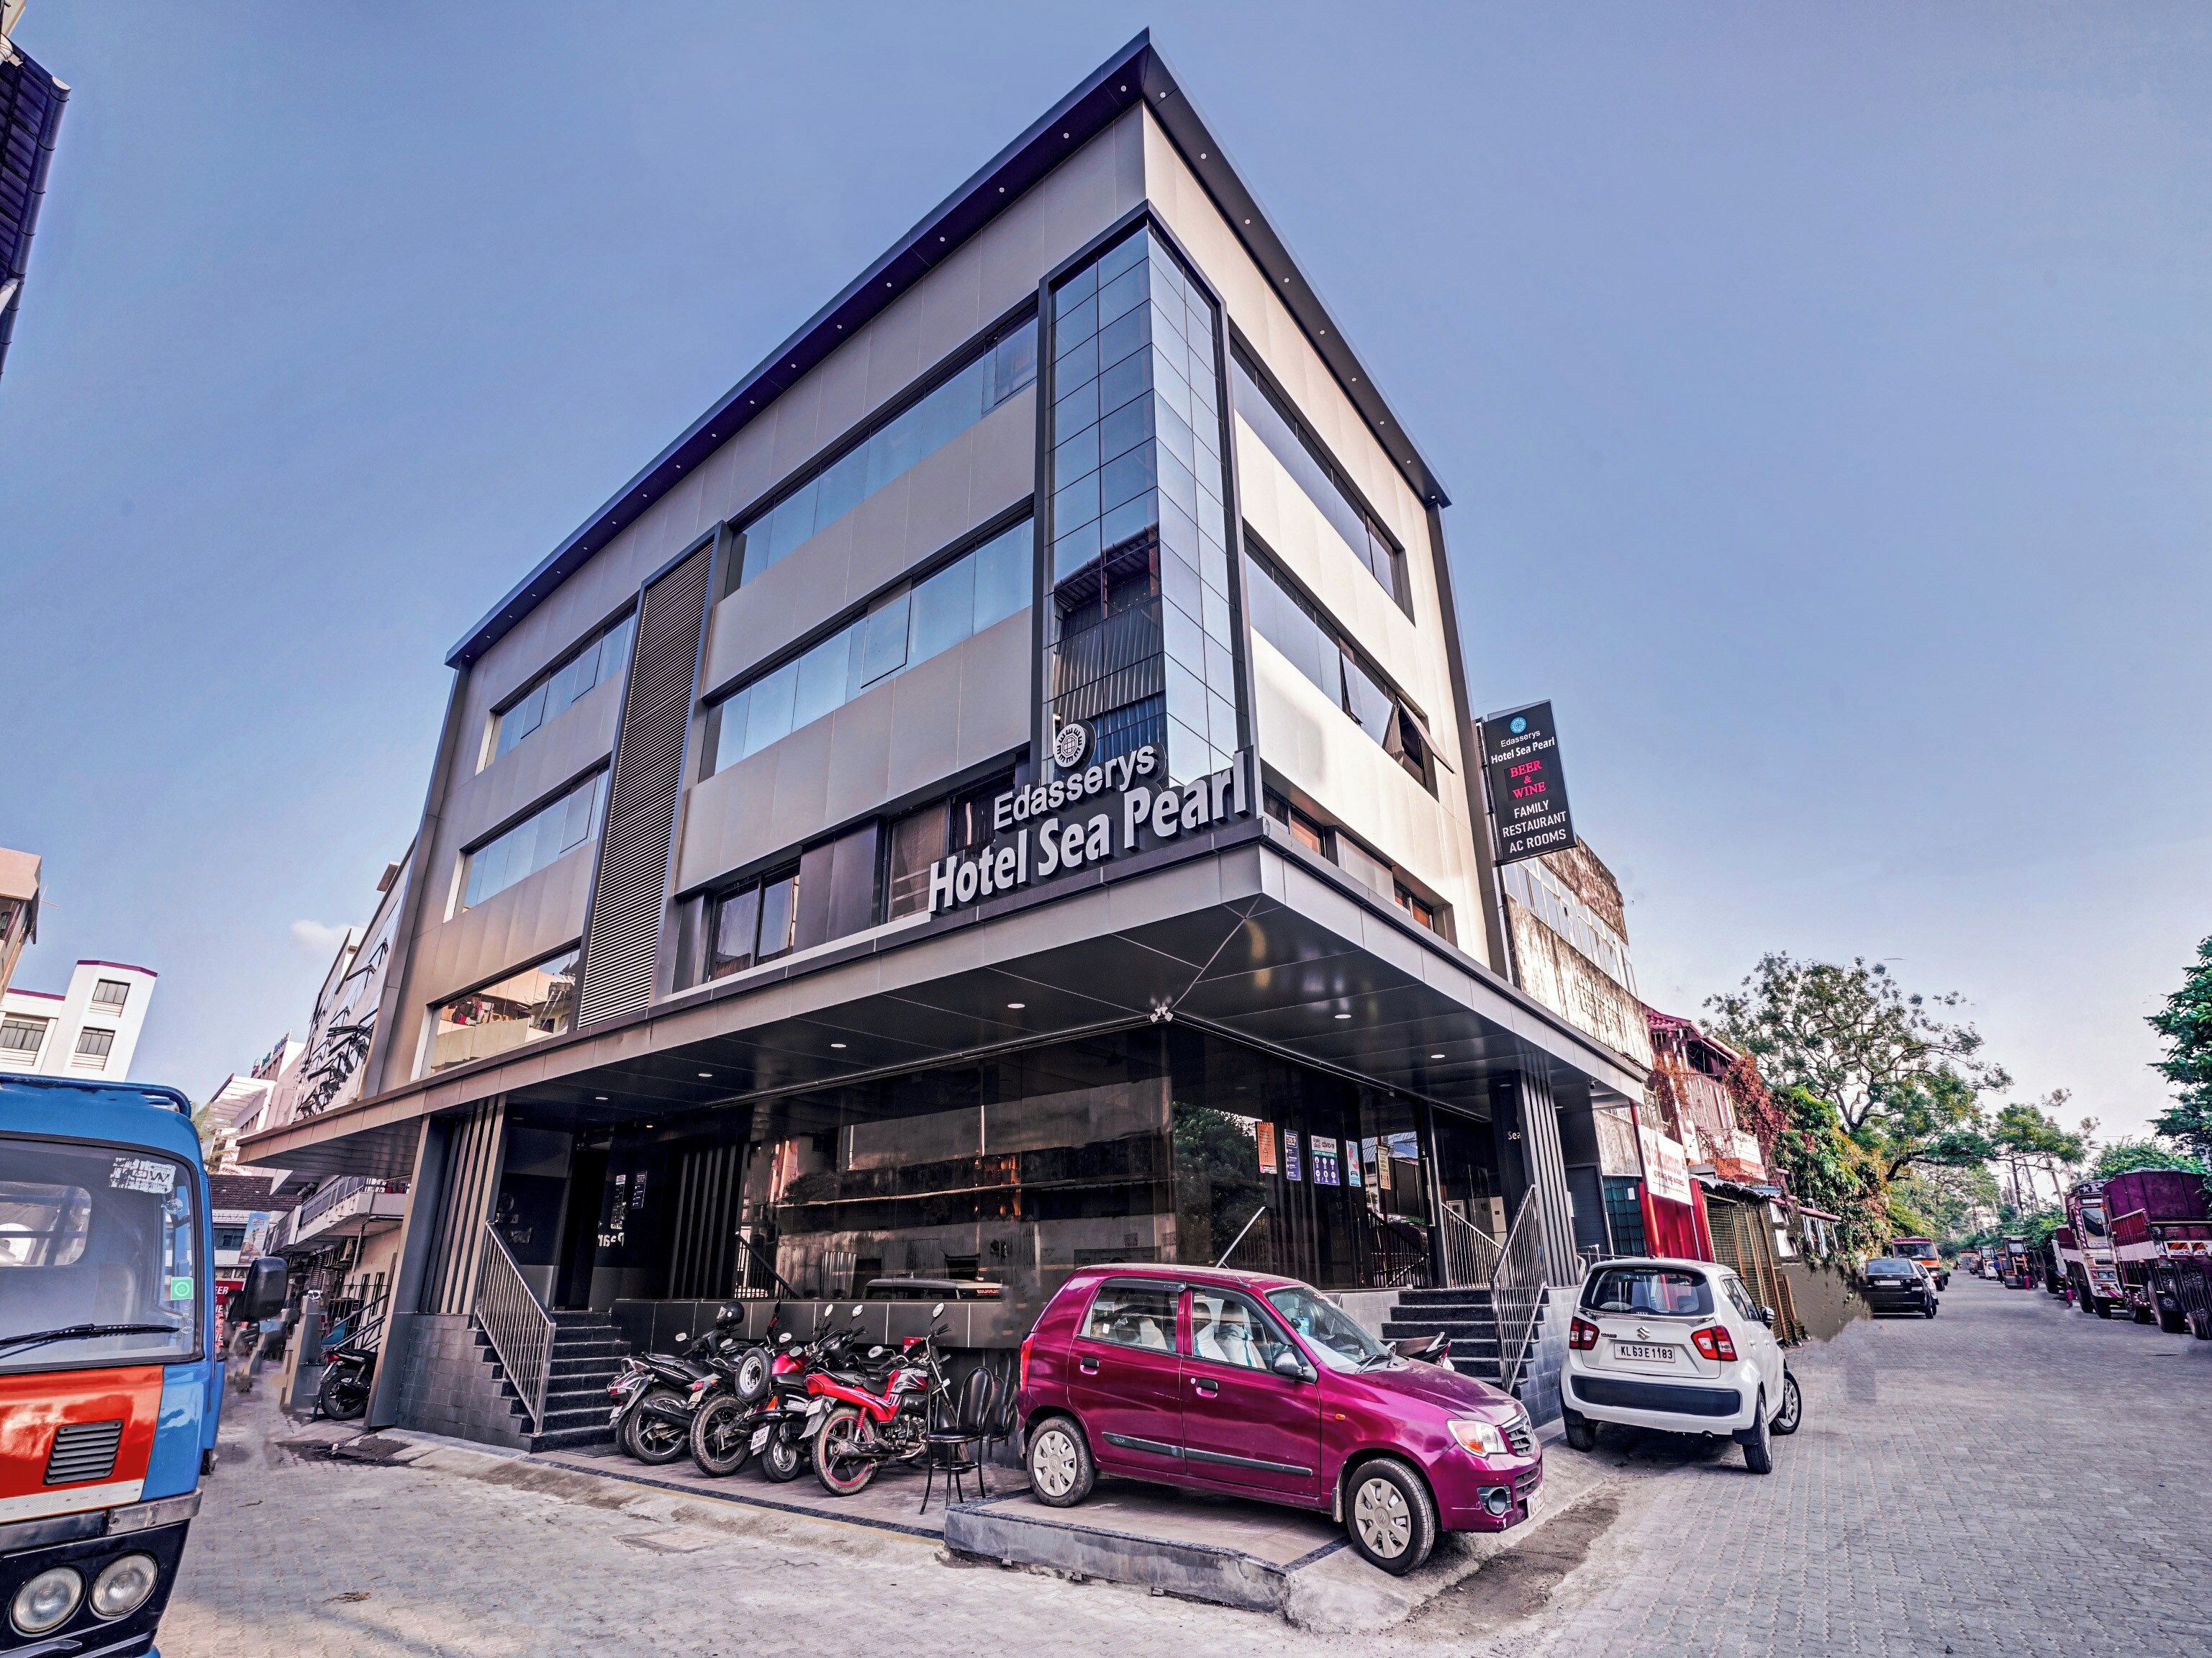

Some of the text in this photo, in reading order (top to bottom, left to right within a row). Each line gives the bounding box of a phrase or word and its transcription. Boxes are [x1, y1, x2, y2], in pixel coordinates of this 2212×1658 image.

[1501, 730, 1541, 748] Edasserys
[1491, 736, 1555, 764] Hotel Sea Pearl
[1510, 760, 1543, 778] BEER
[1523, 775, 1532, 784] &
[994, 746, 1156, 830] Edasserys
[1512, 782, 1546, 799] WINE
[1514, 799, 1549, 818] FAMILY
[928, 751, 1248, 914] Hotel Sea Pearl
[1502, 811, 1567, 838] RESTAURANT
[1510, 829, 1566, 853] AC ROOMS
